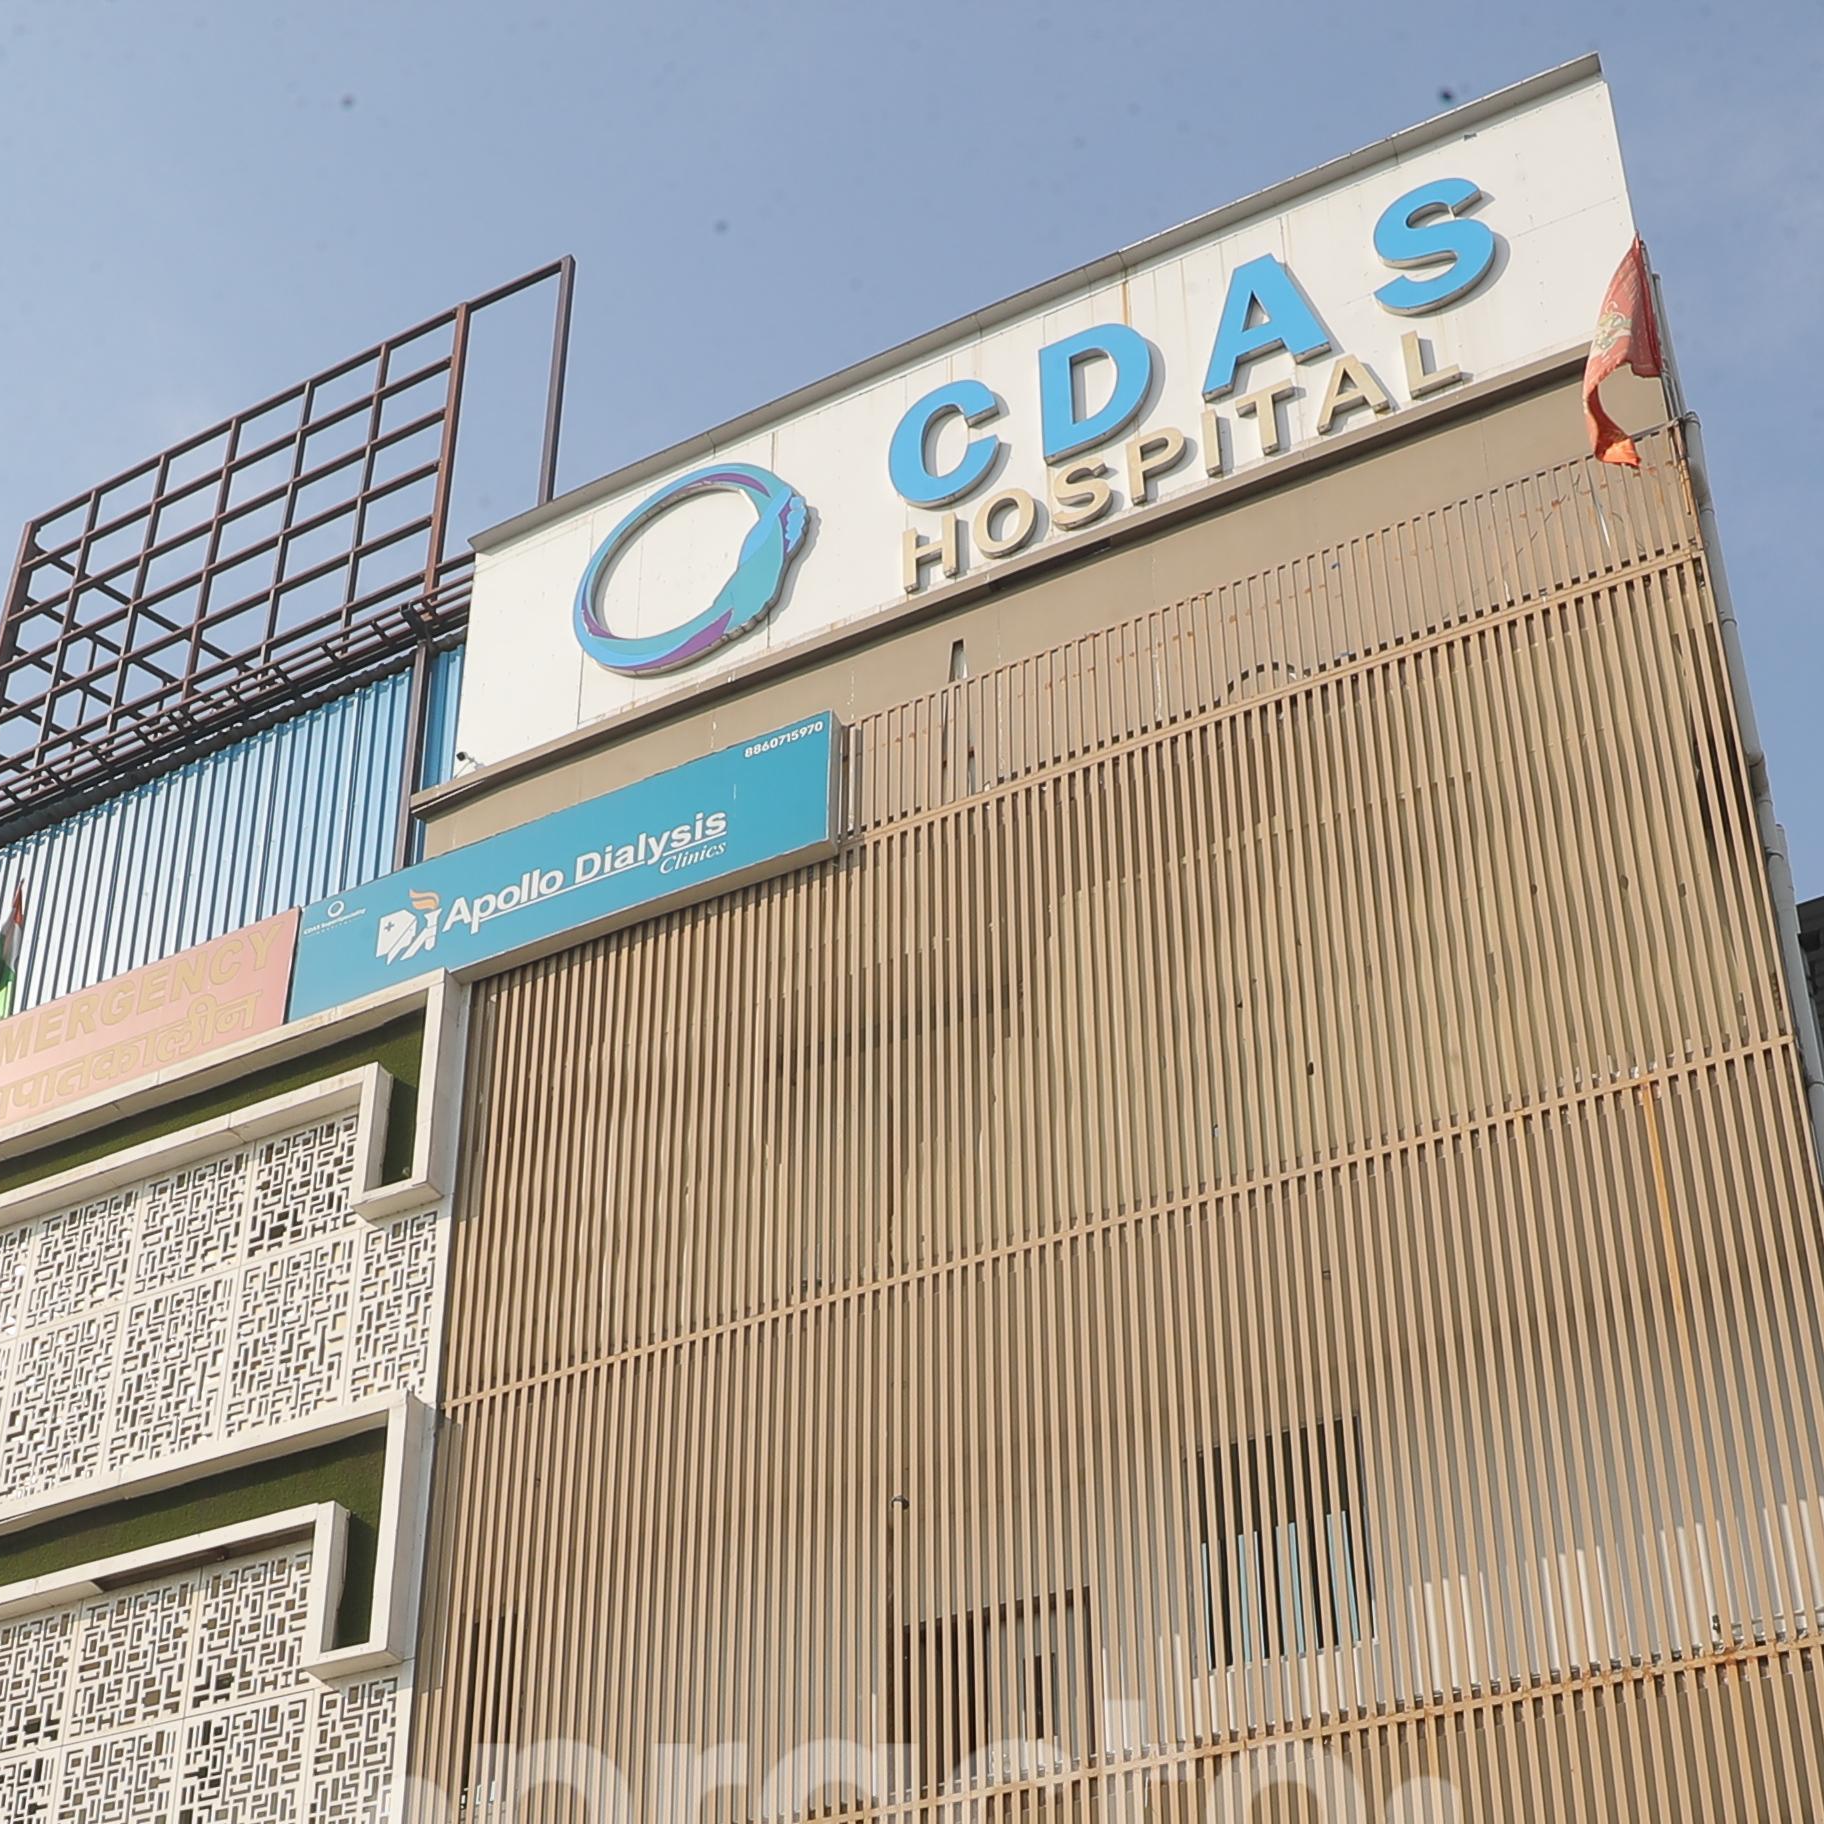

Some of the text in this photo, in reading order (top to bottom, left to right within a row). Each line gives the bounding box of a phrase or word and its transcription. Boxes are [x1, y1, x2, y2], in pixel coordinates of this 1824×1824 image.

[888, 178, 1498, 508] CDAS
[902, 330, 1462, 593] HOSPITAL
[744, 721, 824, 758] 8860715970
[442, 810, 728, 934] Apollo Dialysis
[660, 840, 727, 874] Clinics
